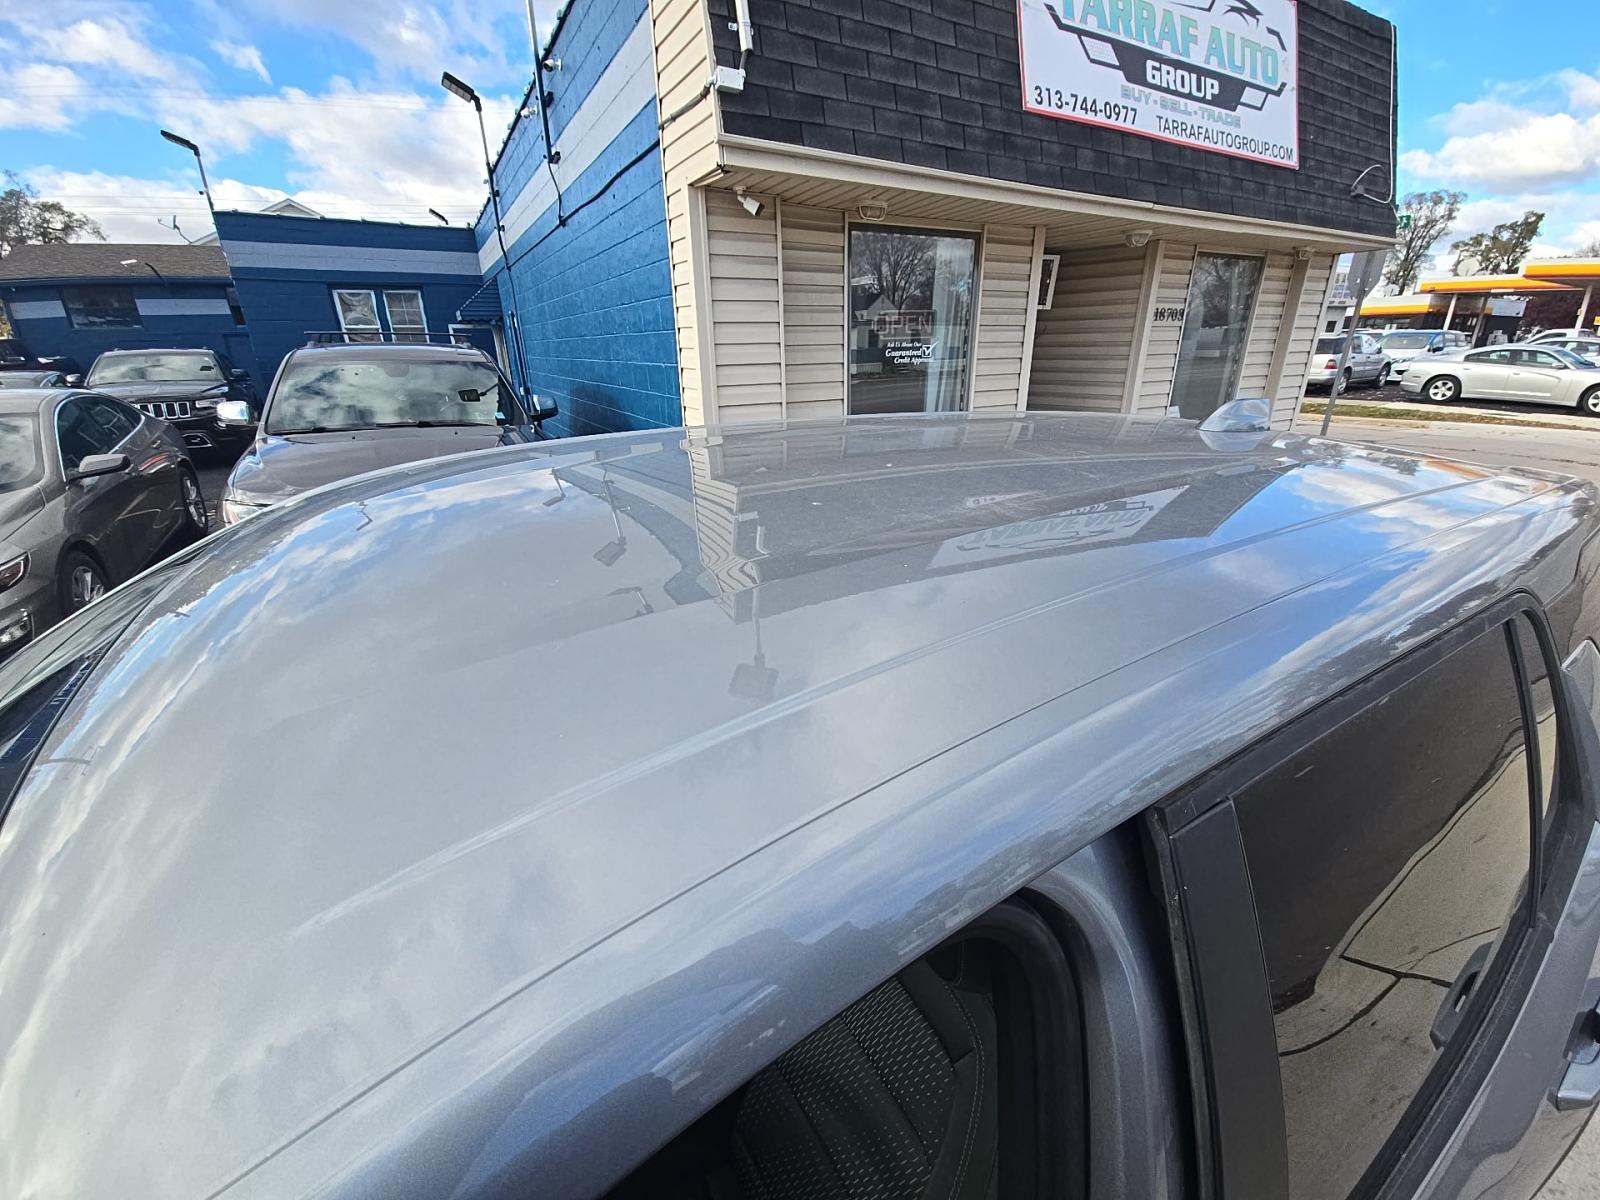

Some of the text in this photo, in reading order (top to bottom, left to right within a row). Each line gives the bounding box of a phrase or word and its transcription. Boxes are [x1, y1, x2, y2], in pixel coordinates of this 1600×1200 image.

[1204, 25, 1279, 86] AUTO
[1145, 59, 1220, 100] GROUP
[1034, 85, 1138, 125] 313-744-0977
[1120, 84, 1241, 128] BUY SELL TRADE
[1156, 115, 1294, 162] TARRAFAUTOGROUP.COM
[874, 315, 932, 334] OPEN
